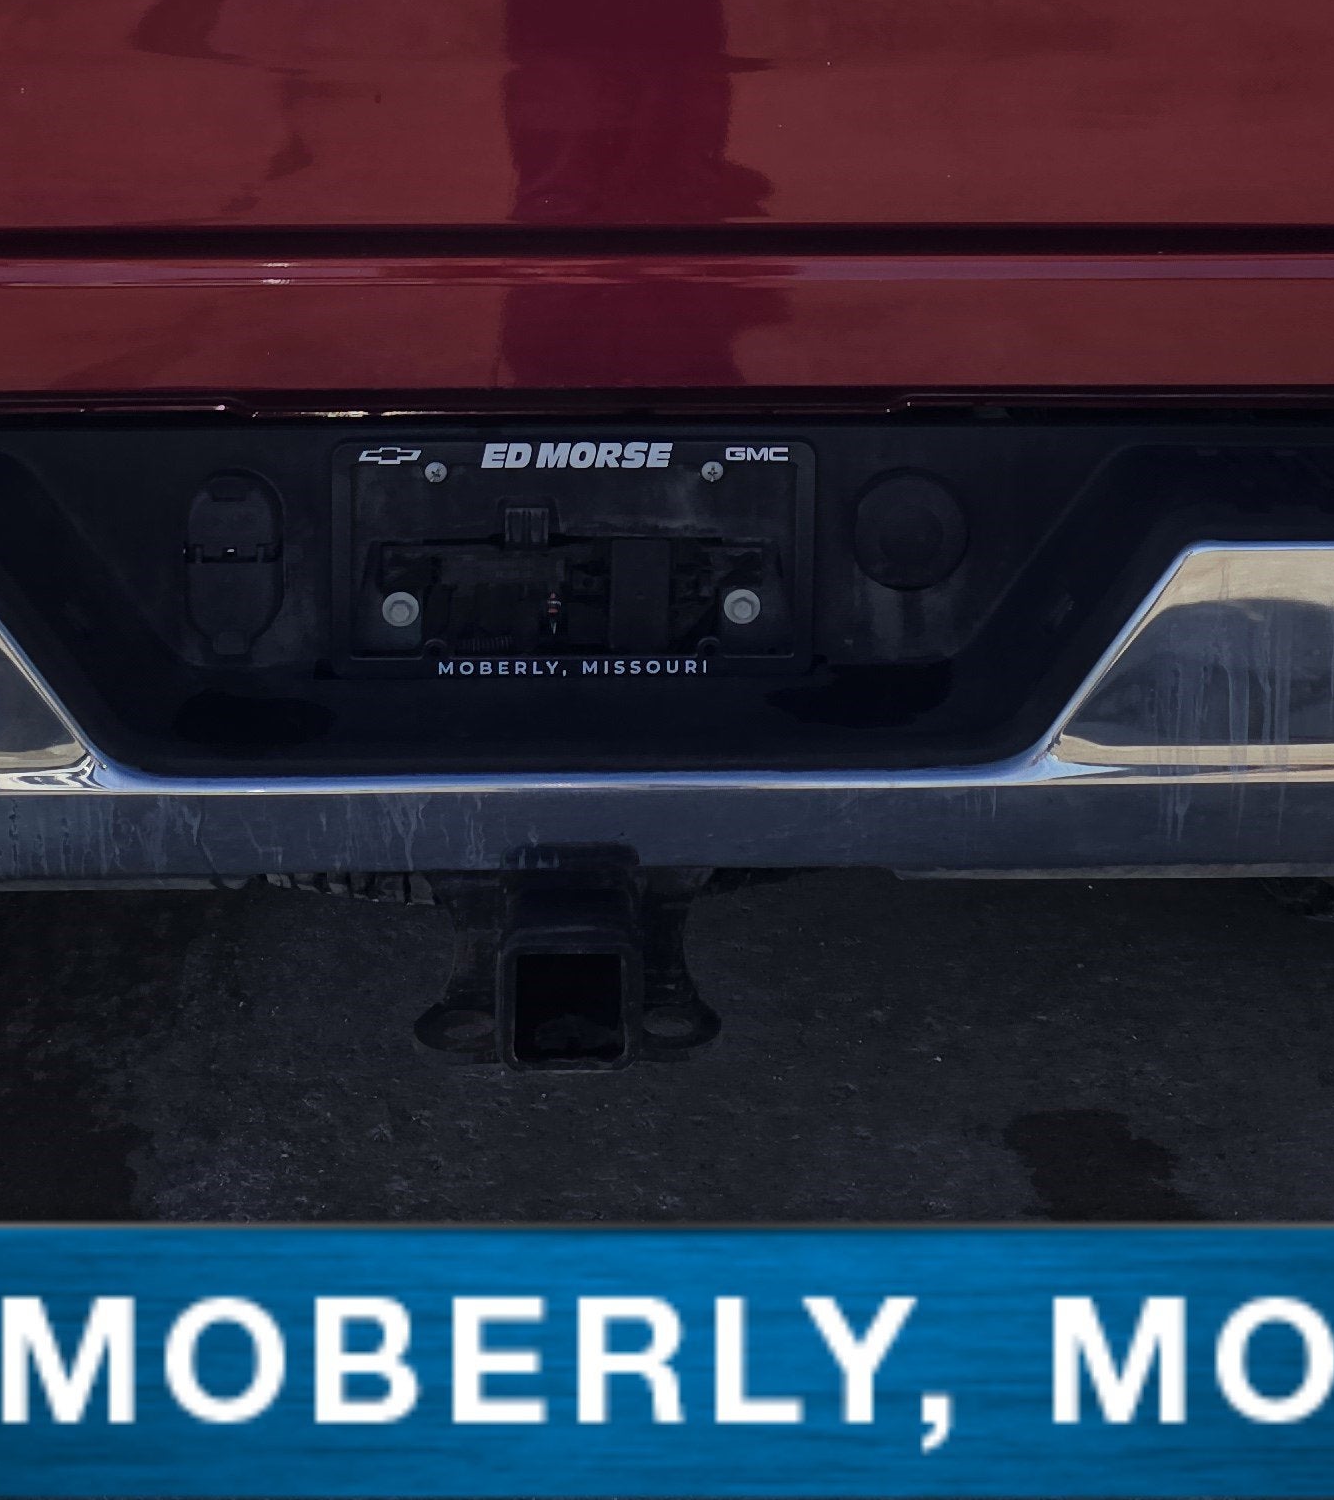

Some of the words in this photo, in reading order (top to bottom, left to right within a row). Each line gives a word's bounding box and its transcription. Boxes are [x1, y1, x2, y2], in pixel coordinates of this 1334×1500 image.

[481, 442, 534, 469] ED
[535, 441, 673, 469] MORSE
[725, 446, 790, 463] GMC
[438, 660, 568, 677] MOBERLY,
[582, 659, 708, 675] MISSOURI
